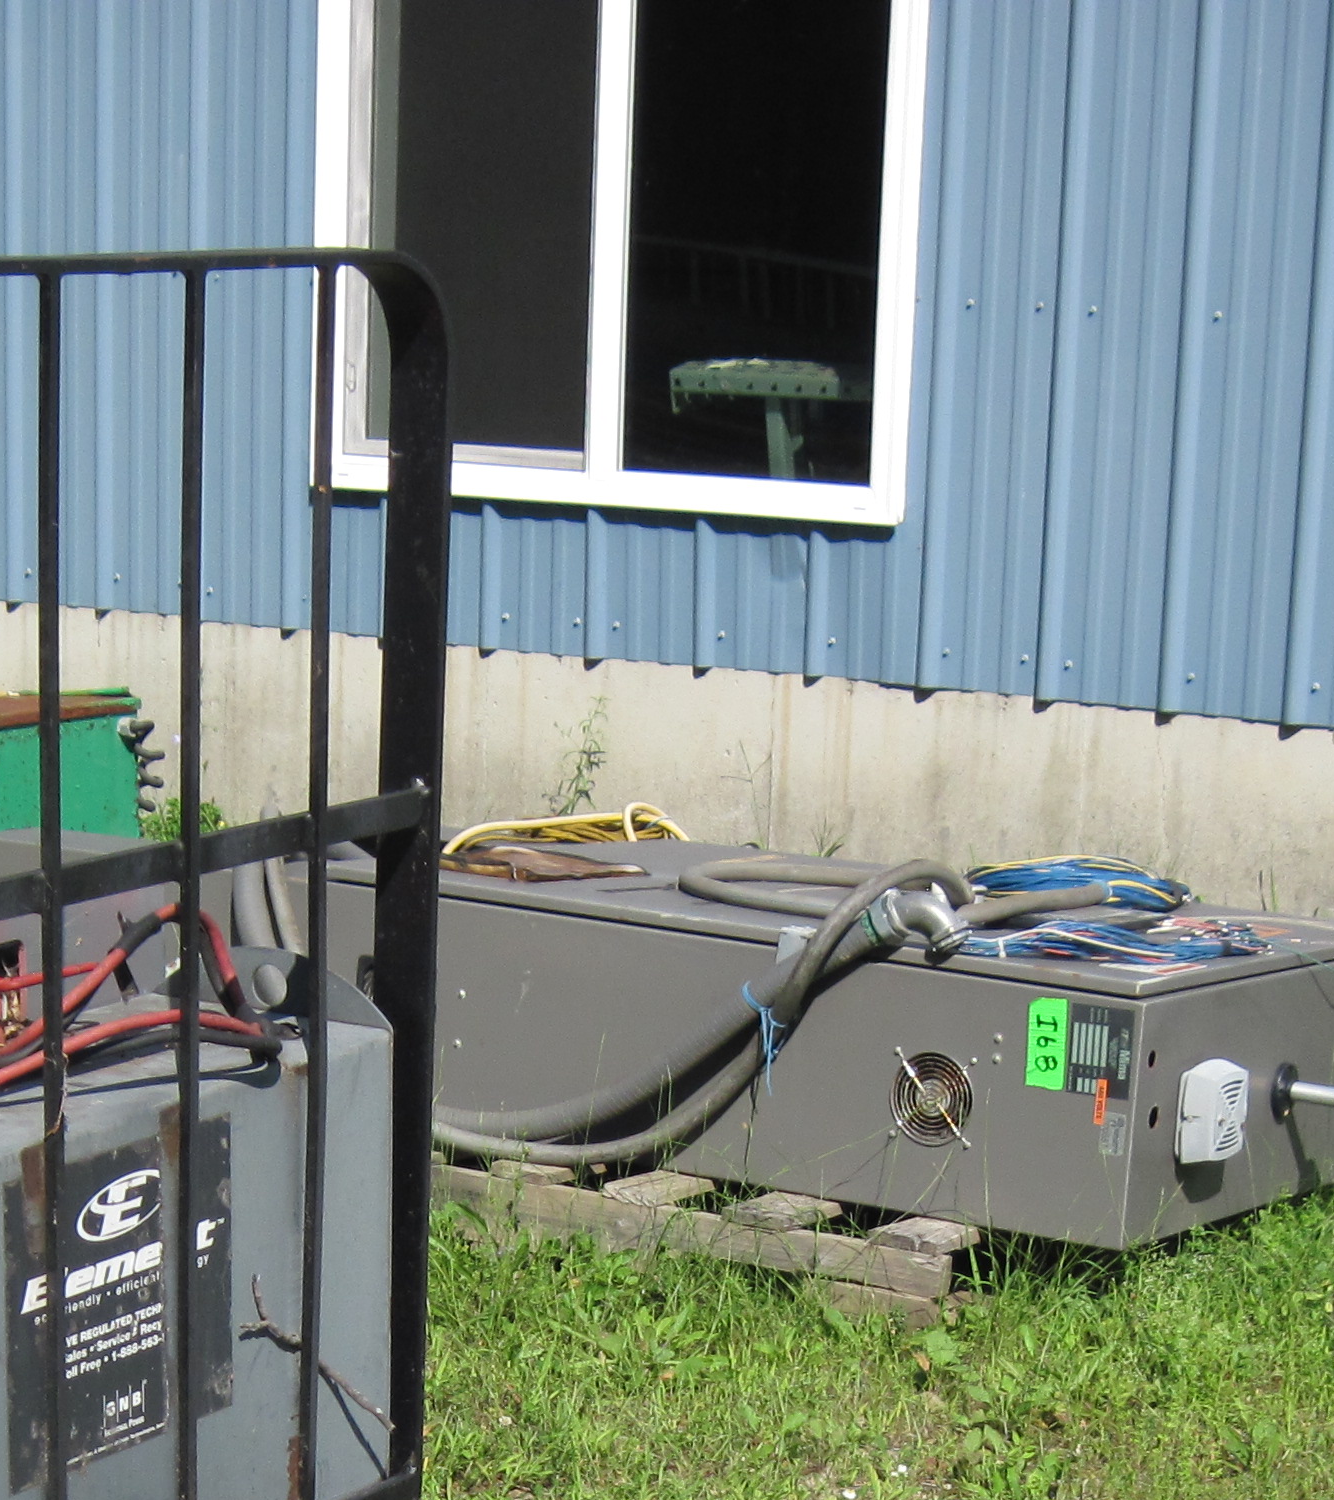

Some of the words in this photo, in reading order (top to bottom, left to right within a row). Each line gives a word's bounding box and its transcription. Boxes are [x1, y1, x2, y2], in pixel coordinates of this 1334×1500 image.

[20, 1219, 217, 1315] Eemet
[80, 1313, 133, 1342] REGULATED
[65, 1364, 78, 1379] oll
[80, 1358, 102, 1374] Free
[105, 1390, 142, 1417] GNB
